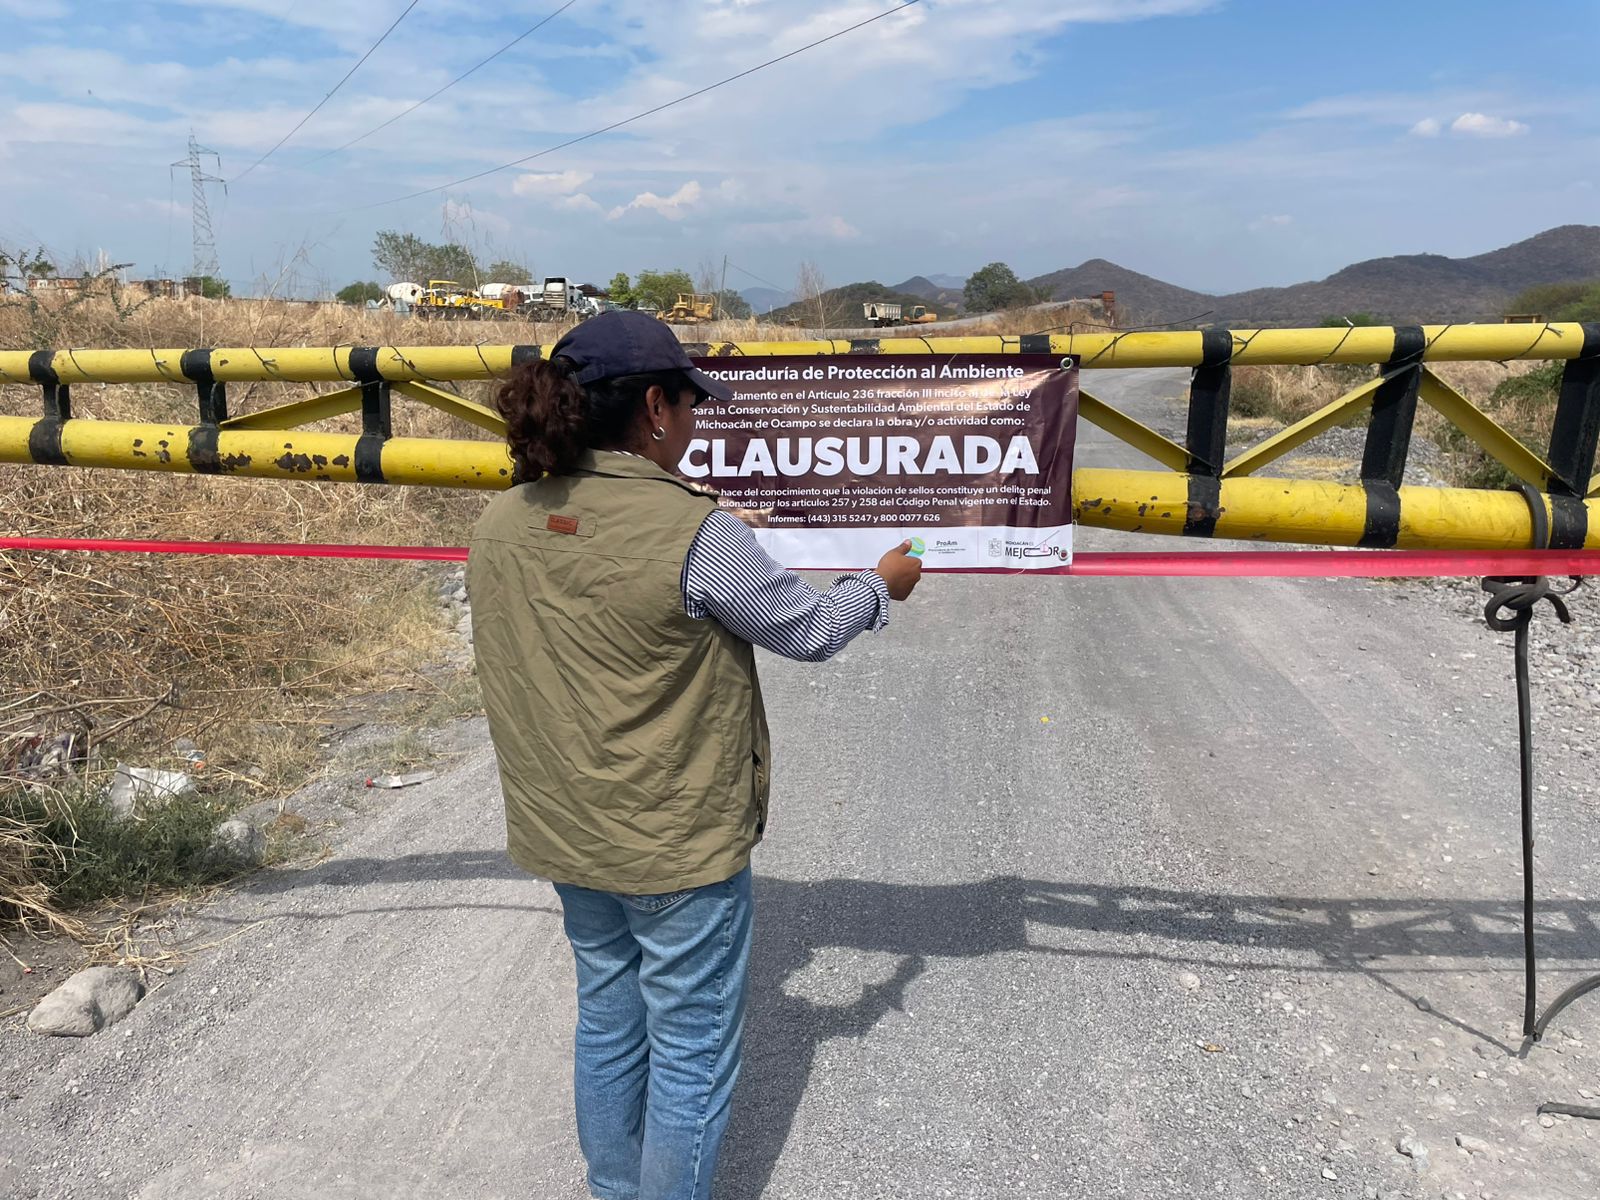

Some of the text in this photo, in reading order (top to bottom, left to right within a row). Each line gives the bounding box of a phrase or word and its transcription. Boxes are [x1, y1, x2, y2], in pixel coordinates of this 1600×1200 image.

[696, 364, 1025, 381] ocuraduría de Protección al Ambiente
[796, 390, 806, 399] el
[808, 389, 850, 399] Artículo
[853, 389, 875, 399] 236
[877, 389, 920, 398] fracción
[922, 389, 932, 398] III
[1013, 387, 1032, 399] Ley
[717, 405, 725, 415] la
[728, 404, 800, 414] Conservación
[802, 406, 809, 416] y
[811, 403, 894, 413] Sustentabilidad
[897, 402, 954, 412] Ambiental
[956, 402, 973, 411] del
[976, 401, 1014, 411] Estado
[1016, 401, 1031, 411] de
[695, 415, 1025, 430] Michoacán de Ocampo se declara la obra y/o actividad como:
[677, 435, 1040, 479] CLAUSURADA
[721, 488, 743, 496] hace
[744, 488, 758, 496] del
[760, 487, 821, 496] conocimiento
[822, 488, 840, 498] que
[842, 486, 850, 495] la
[852, 486, 893, 495] violación
[895, 486, 907, 495] de
[908, 486, 934, 494] sellos
[936, 486, 984, 496] constituye
[986, 486, 998, 494] un
[999, 485, 1025, 495] delito
[1027, 486, 1052, 496] penal
[717, 499, 757, 508] ncionado
[760, 501, 775, 510] por
[777, 499, 790, 507] los
[792, 498, 829, 507] artículos
[831, 498, 850, 507] 257
[851, 500, 857, 509] y
[859, 498, 878, 506] 258
[879, 497, 894, 506] del
[896, 497, 930, 508] Código
[932, 497, 957, 506] Penal
[960, 497, 994, 507] vigente
[1010, 497, 1017, 505] el
[1019, 497, 1052, 506] Estado.
[767, 515, 806, 523] Informes:
[808, 514, 831, 524] (443)
[849, 514, 871, 522] 5247
[873, 516, 878, 524] y
[880, 514, 898, 522] 800
[899, 514, 922, 522] 0077
[923, 514, 940, 522] 626
